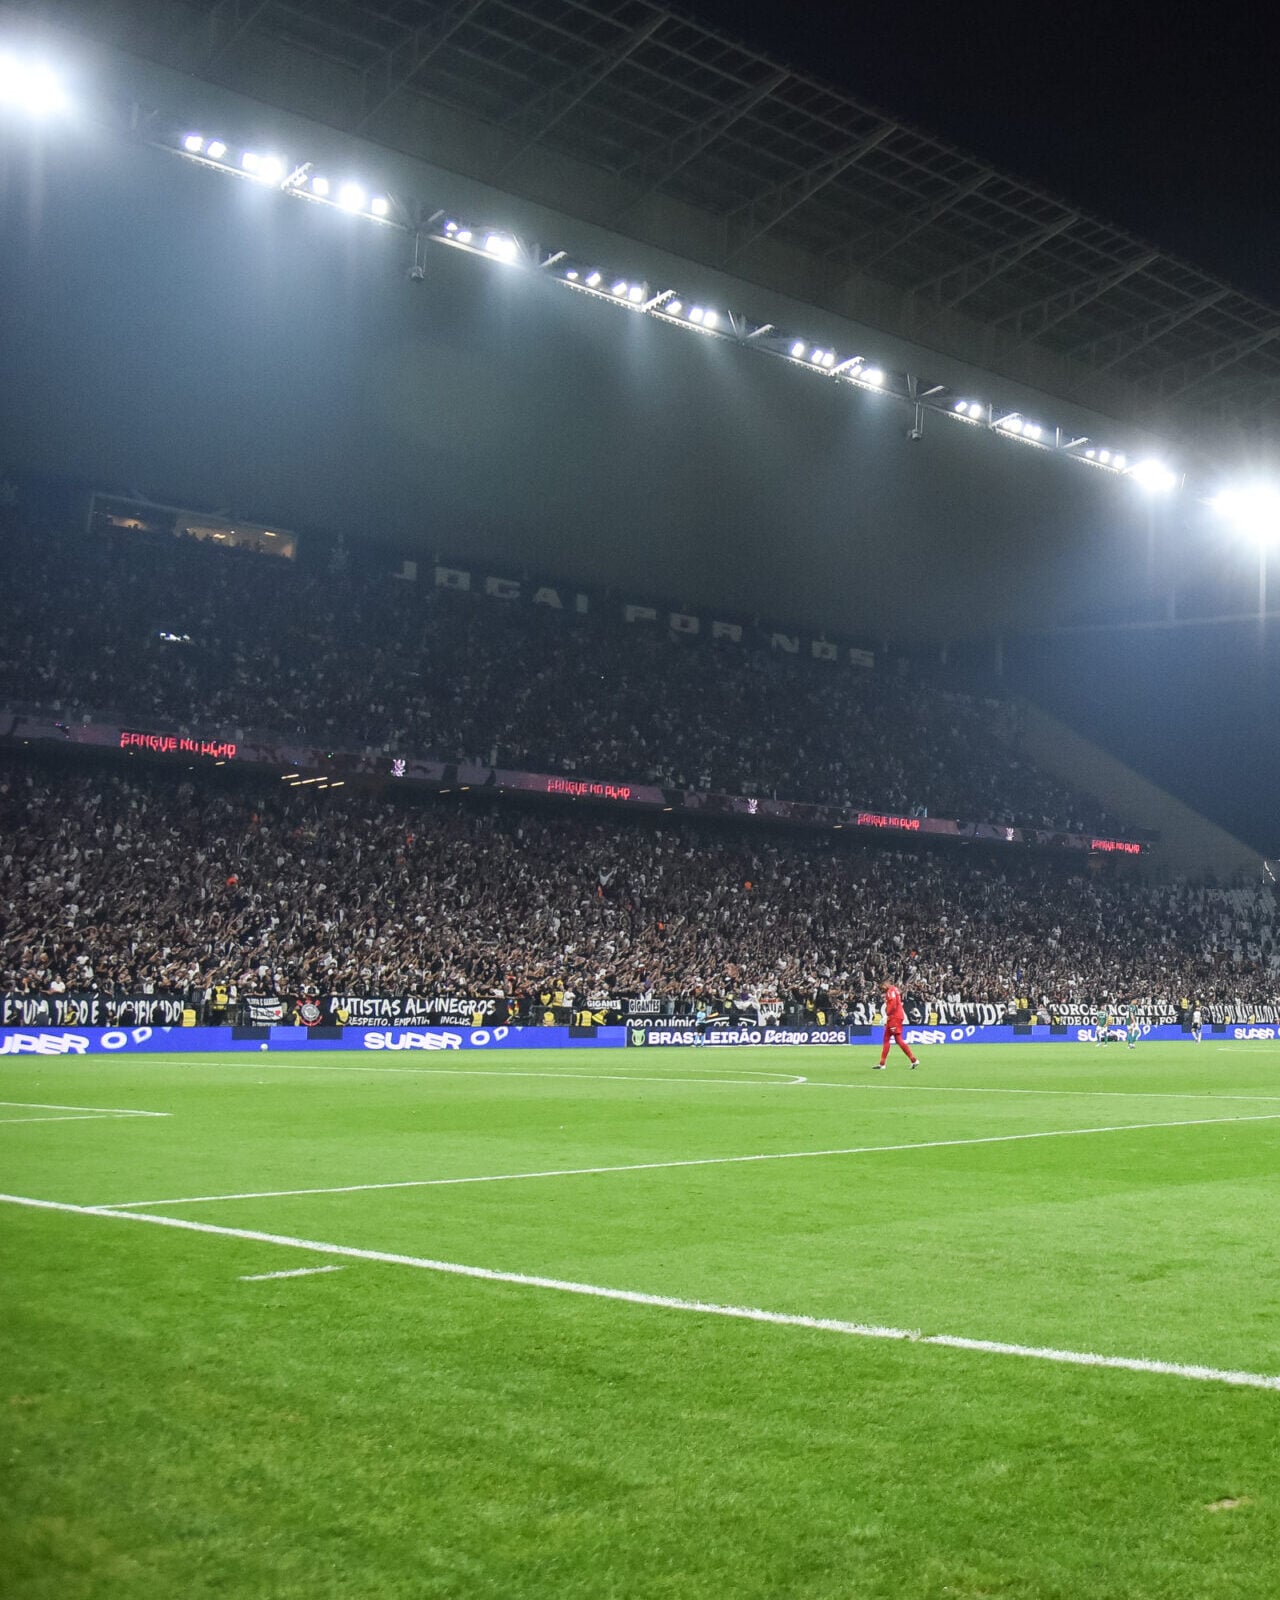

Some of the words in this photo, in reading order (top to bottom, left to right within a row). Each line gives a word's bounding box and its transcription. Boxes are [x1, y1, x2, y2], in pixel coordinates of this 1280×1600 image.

[392, 560, 588, 614] JOGAI
[120, 732, 177, 752] SANGUE
[330, 997, 402, 1017] AUTISTAS
[405, 997, 496, 1016] ALVINEGROS
[363, 1031, 462, 1050] SUPER
[810, 1031, 846, 1044] 2026
[1234, 1027, 1276, 1040] SUPER
[0, 1033, 90, 1055] UPER
